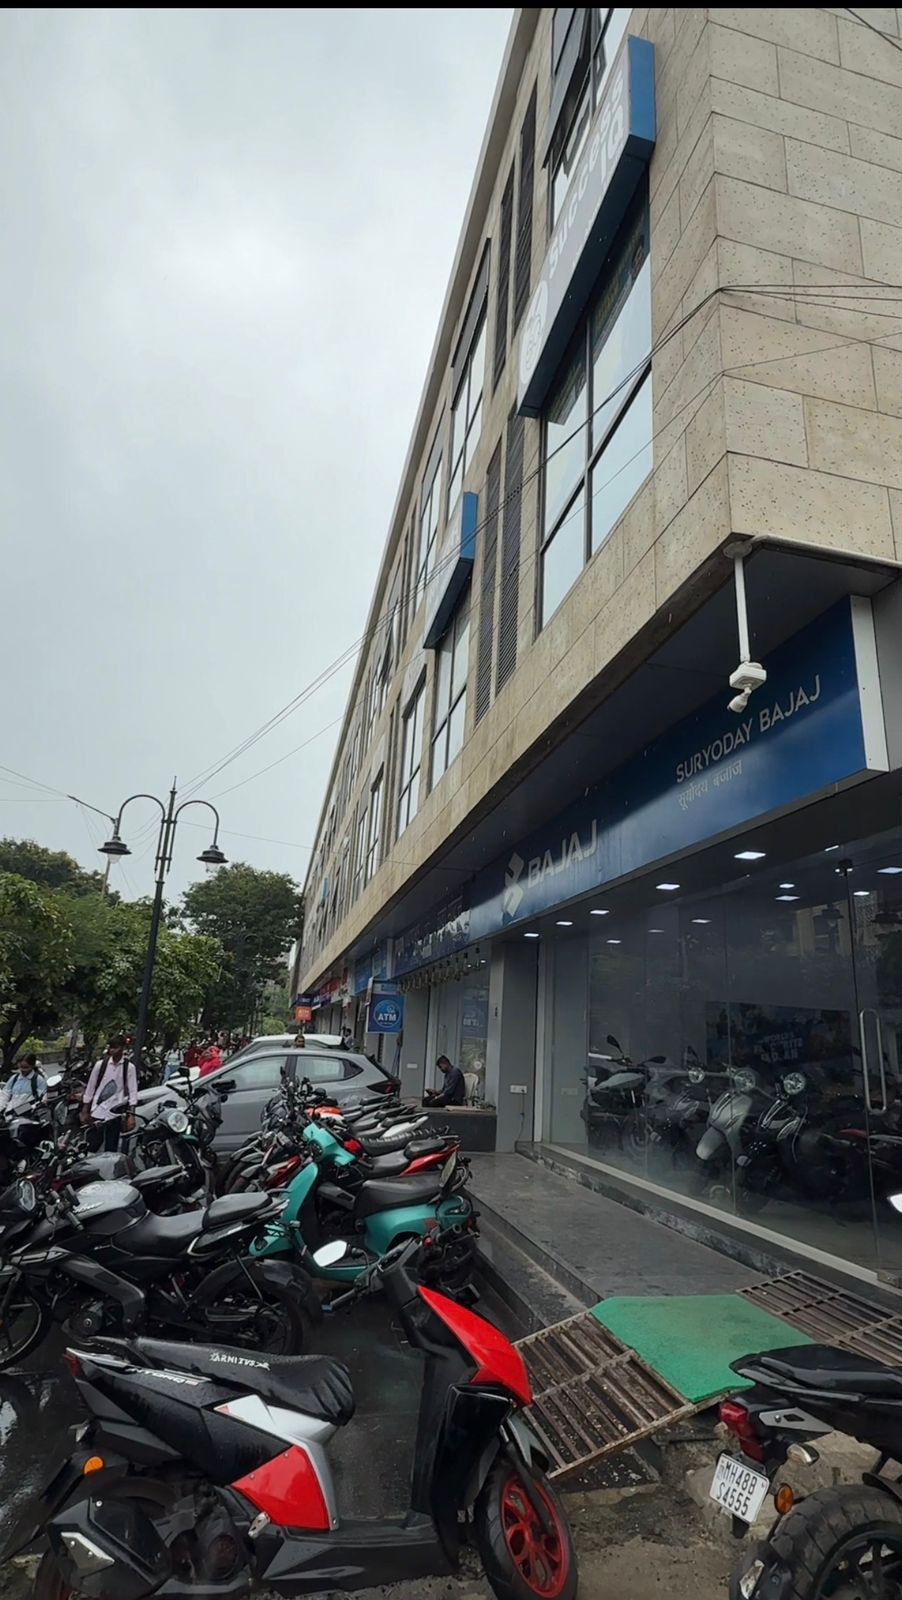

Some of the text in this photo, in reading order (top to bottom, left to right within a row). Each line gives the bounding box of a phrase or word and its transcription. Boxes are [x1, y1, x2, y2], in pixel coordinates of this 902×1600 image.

[676, 674, 821, 783] SURYODAY BAJAJ
[678, 759, 743, 811] सूर्योदय बजाज
[527, 818, 598, 889] BAJAJ
[378, 1013, 396, 1021] ATM
[716, 1482, 751, 1516] S4555
[722, 1461, 758, 1495] MH48B
